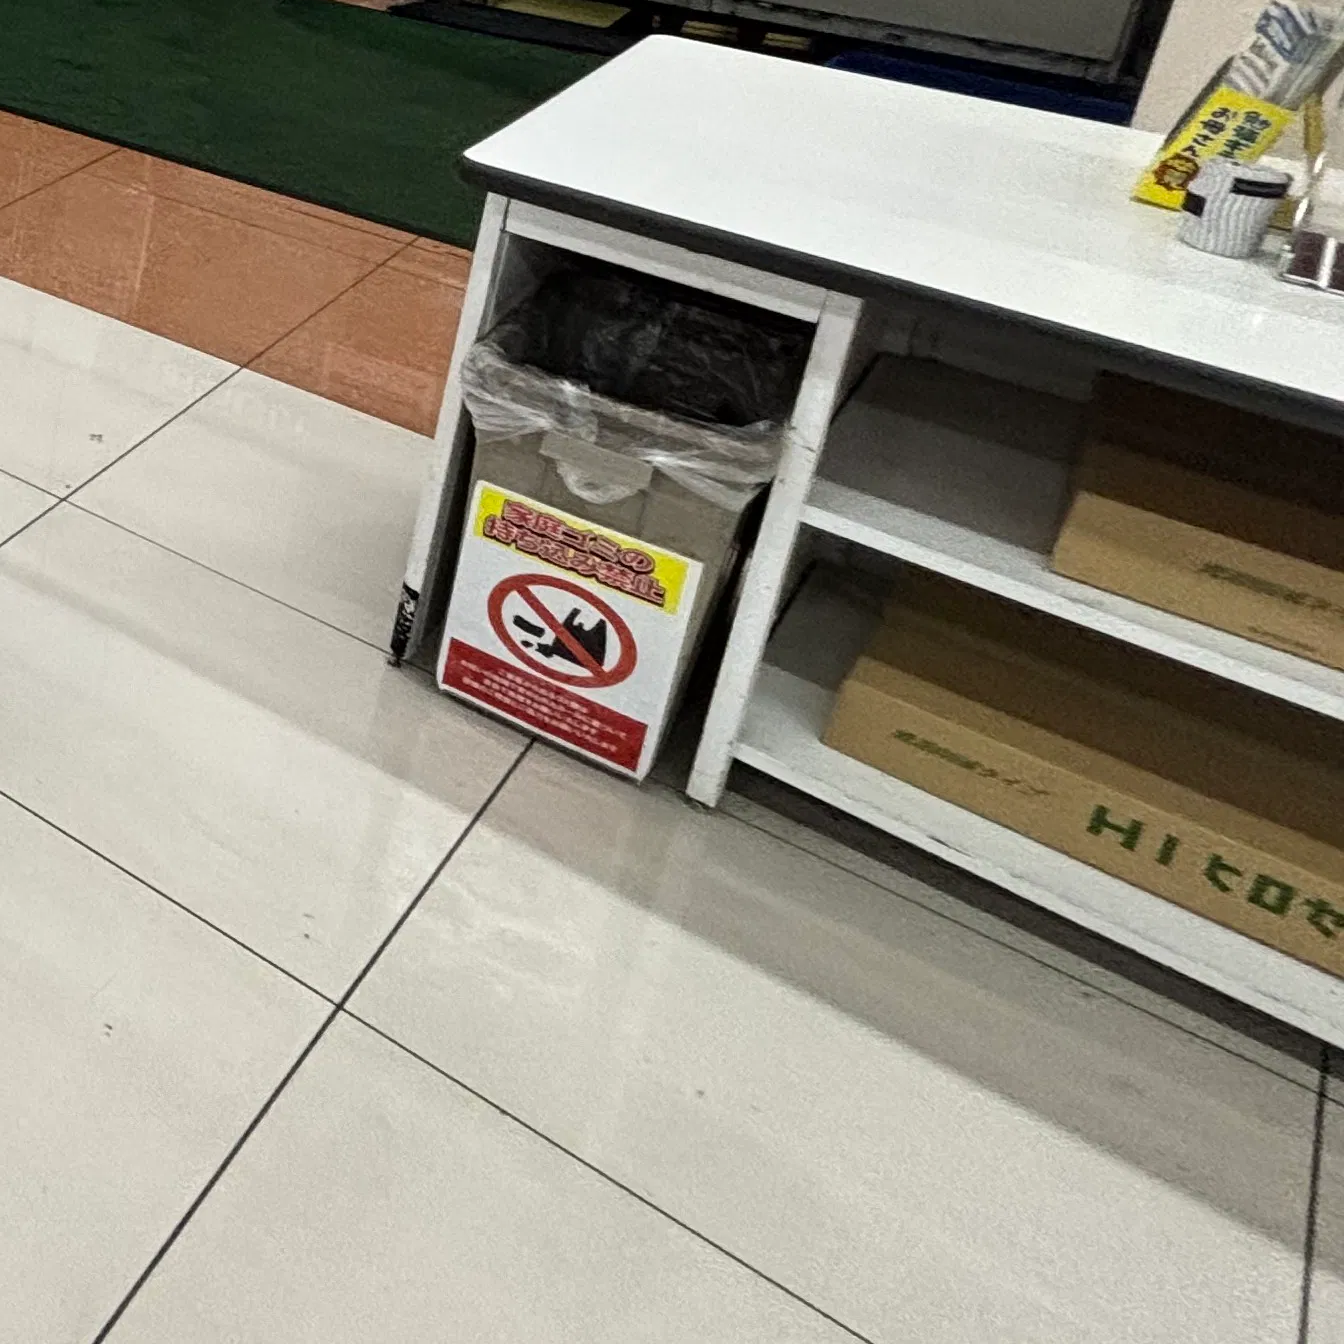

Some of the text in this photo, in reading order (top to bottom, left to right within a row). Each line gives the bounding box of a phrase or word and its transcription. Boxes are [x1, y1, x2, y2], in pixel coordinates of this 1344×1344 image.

[483, 513, 667, 608] 持ち込み禁止
[503, 498, 657, 574] 家庭ゴミの
